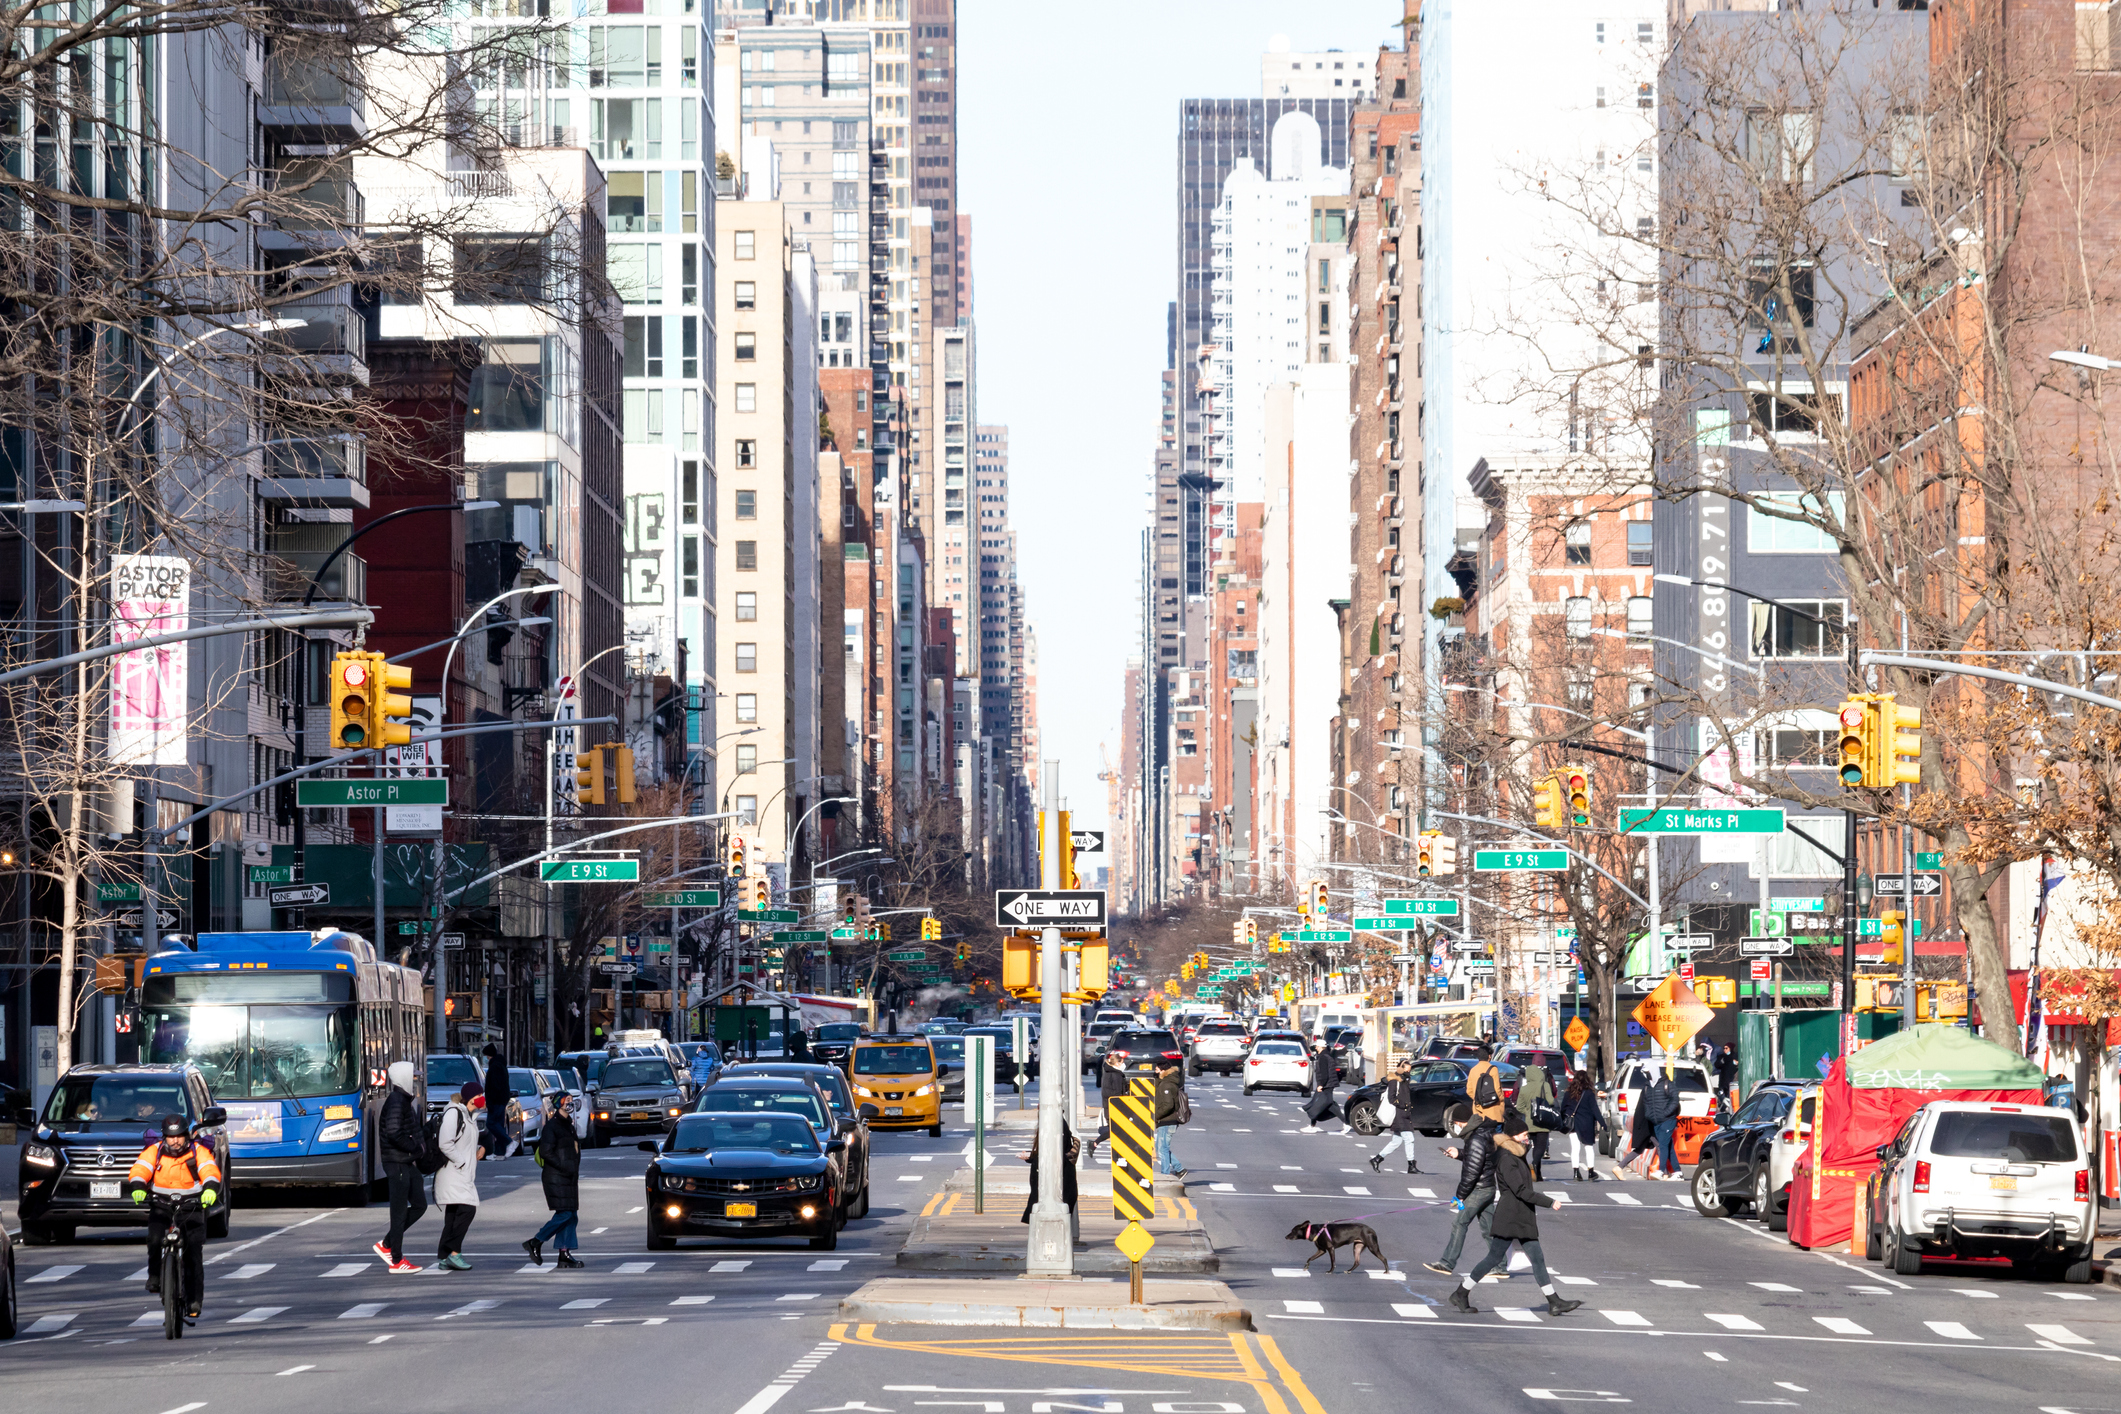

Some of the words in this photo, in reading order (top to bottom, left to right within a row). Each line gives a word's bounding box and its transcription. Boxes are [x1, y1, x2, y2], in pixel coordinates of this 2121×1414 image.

[117, 565, 185, 582] ASTOR
[119, 581, 181, 599] PLACE
[1705, 725, 1750, 736] ATOR
[1706, 736, 1749, 747] PCE
[401, 744, 424, 753] FREE
[402, 752, 424, 760] WIFI
[347, 785, 382, 800] Astor
[388, 785, 399, 799] Pl
[1666, 814, 1679, 828] St
[1685, 814, 1722, 828] Marks
[1728, 814, 1739, 828] Pl
[1075, 837, 1094, 846] WAY
[1504, 855, 1511, 866] E
[1515, 855, 1523, 866] 9
[1527, 854, 1539, 866] St
[1926, 854, 1935, 863] St
[571, 865, 578, 877] E
[583, 865, 591, 877] 9
[595, 865, 608, 877] St
[254, 872, 280, 881] Astor
[1880, 880, 1900, 889] ONE
[101, 887, 128, 898] Astor
[274, 892, 291, 901] ONE
[301, 889, 321, 900] WAY
[665, 894, 670, 903] E
[674, 894, 683, 903] 10
[687, 894, 697, 904] St
[1771, 898, 1813, 910] STUYVESANT
[1014, 901, 1044, 915] ONE
[1059, 901, 1092, 915] WAY
[1406, 902, 1411, 911] E
[1415, 902, 1424, 911] 10
[1427, 902, 1437, 912] St
[125, 915, 143, 924] ONE
[756, 911, 761, 919] E
[764, 911, 769, 920] 11
[771, 911, 779, 920] St
[1373, 920, 1377, 928] E
[1381, 920, 1386, 928] 11
[1388, 919, 1396, 928] St
[1866, 921, 1876, 933] St
[1880, 921, 1897, 933] Mar
[788, 933, 793, 941] E
[795, 933, 801, 941] 12
[803, 932, 811, 941] St
[1645, 1001, 1665, 1009] LANE
[1645, 1014, 1671, 1022] PLEASE
[1675, 1014, 1699, 1022] MERGE
[1570, 1026, 1583, 1034] RAISE
[2058, 1096, 2068, 1108] P
